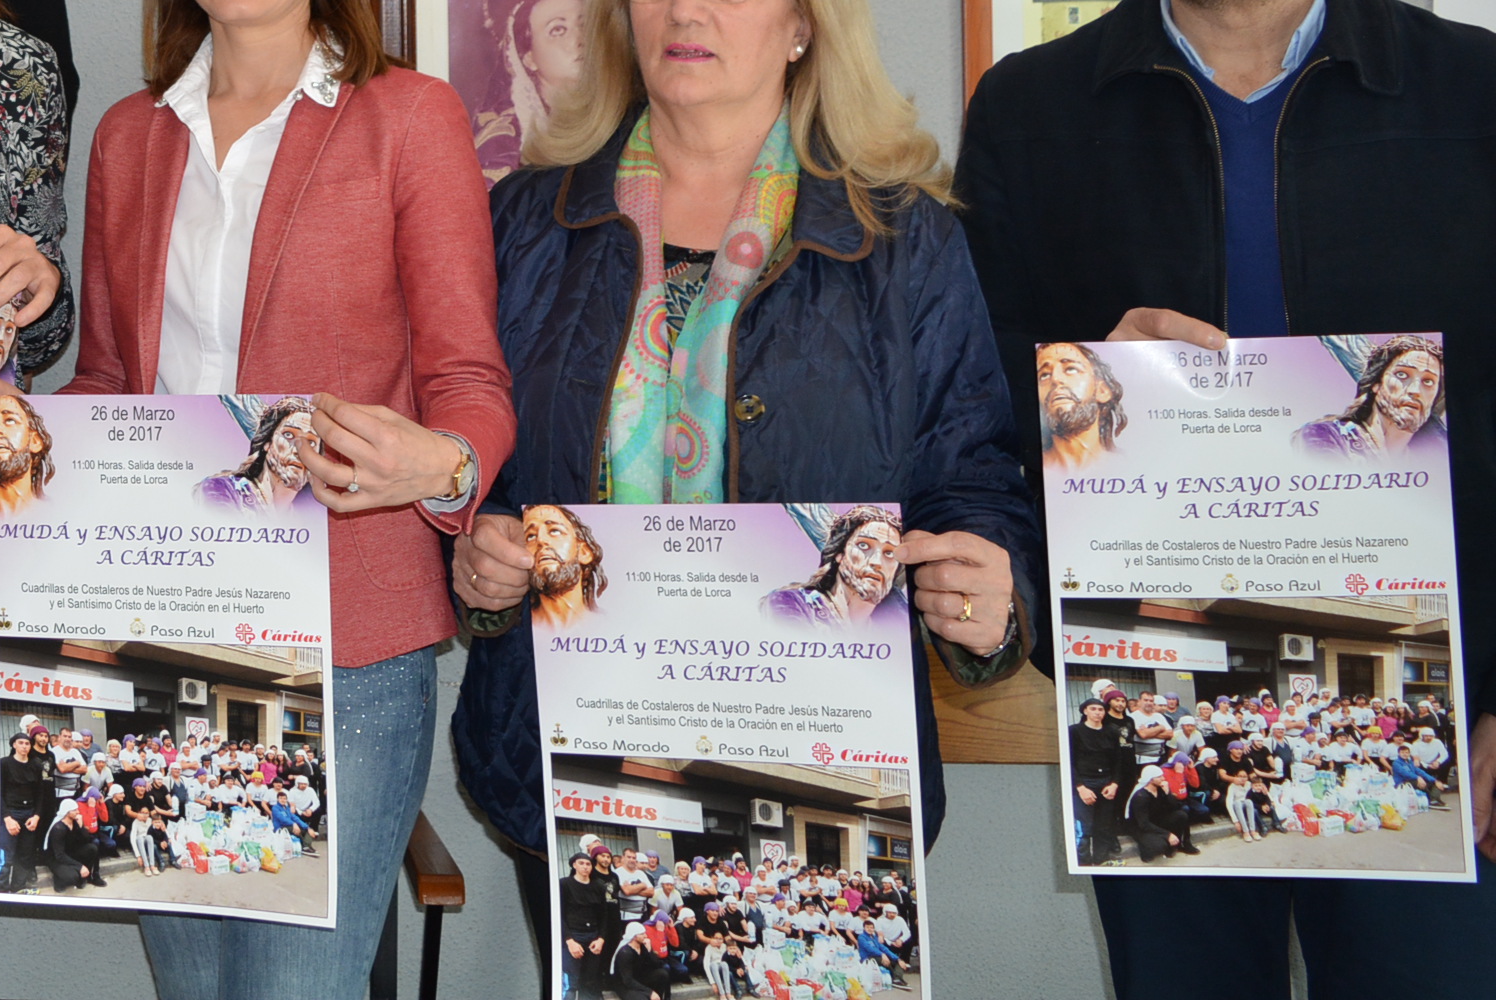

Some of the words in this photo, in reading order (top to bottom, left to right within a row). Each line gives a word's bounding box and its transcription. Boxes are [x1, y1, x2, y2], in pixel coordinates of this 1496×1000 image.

[1192, 351, 1213, 367] de
[1189, 372, 1209, 389] de
[91, 405, 107, 421] 26
[111, 405, 128, 421] de
[133, 405, 175, 421] Marzo
[107, 426, 124, 441] de
[128, 425, 162, 441] 2017
[1181, 423, 1215, 434] Puerta
[1217, 423, 1230, 433] de
[1233, 423, 1262, 433] Lorca
[1062, 474, 1147, 494] MUDÁ
[1154, 481, 1168, 499] y
[1176, 475, 1280, 496] ENSAYO
[1288, 471, 1429, 491] SOLIDARIO
[1180, 503, 1200, 519] A
[1208, 498, 1319, 518] CÁRITAS
[643, 515, 661, 531] 26
[666, 515, 684, 531] de
[689, 515, 736, 531] Marzo
[0, 521, 70, 539] MUDÁ
[76, 528, 87, 545] y
[94, 525, 182, 544] ENSAYO
[189, 526, 309, 544] SOLIDARIO
[663, 536, 681, 552] de
[686, 536, 722, 552] 2017
[96, 549, 114, 564] A
[120, 546, 215, 567] CÁRITAS
[626, 571, 651, 582] 11:00
[653, 571, 684, 582] Horas.
[686, 571, 716, 582] Salida
[718, 572, 748, 582] desde
[750, 572, 759, 582] la
[1375, 577, 1446, 590] Cáritas
[656, 586, 688, 597] Puerta
[690, 586, 702, 597] de
[704, 587, 731, 597] Lorca
[1086, 581, 1124, 593] Paso
[1129, 581, 1192, 593] Morado
[1245, 580, 1283, 592] Paso
[1288, 579, 1320, 591] Azul
[17, 621, 49, 633] Paso
[53, 622, 106, 635] Morado
[150, 624, 183, 637] Paso
[187, 626, 214, 638] Azul
[261, 629, 321, 642] Cáritas
[550, 634, 627, 653] MUDÁ
[633, 642, 646, 659] y
[654, 639, 750, 659] ENSAYO
[757, 641, 891, 660] SOLIDARIO
[657, 664, 676, 679] A
[683, 661, 786, 683] CÁRITAS
[576, 697, 624, 710] Cuadrillas
[626, 699, 639, 710] de
[641, 699, 694, 712] Costaleros
[696, 701, 710, 712] de
[712, 701, 752, 714] Nuestro
[754, 702, 785, 715] Padre
[788, 704, 819, 716] Jesús
[821, 705, 872, 718] Nazareno
[607, 716, 613, 727] y
[615, 714, 624, 724] el
[678, 715, 708, 727] Cristo
[710, 717, 723, 728] de
[725, 717, 735, 728] la
[737, 717, 777, 730] Oración
[780, 722, 793, 731] en
[796, 720, 805, 731] el
[808, 720, 843, 733] Huerto
[574, 737, 608, 750] Paso
[612, 739, 670, 753] Morado
[718, 743, 754, 756] Paso
[758, 744, 789, 757] Azul
[840, 749, 908, 763] Cáritas
